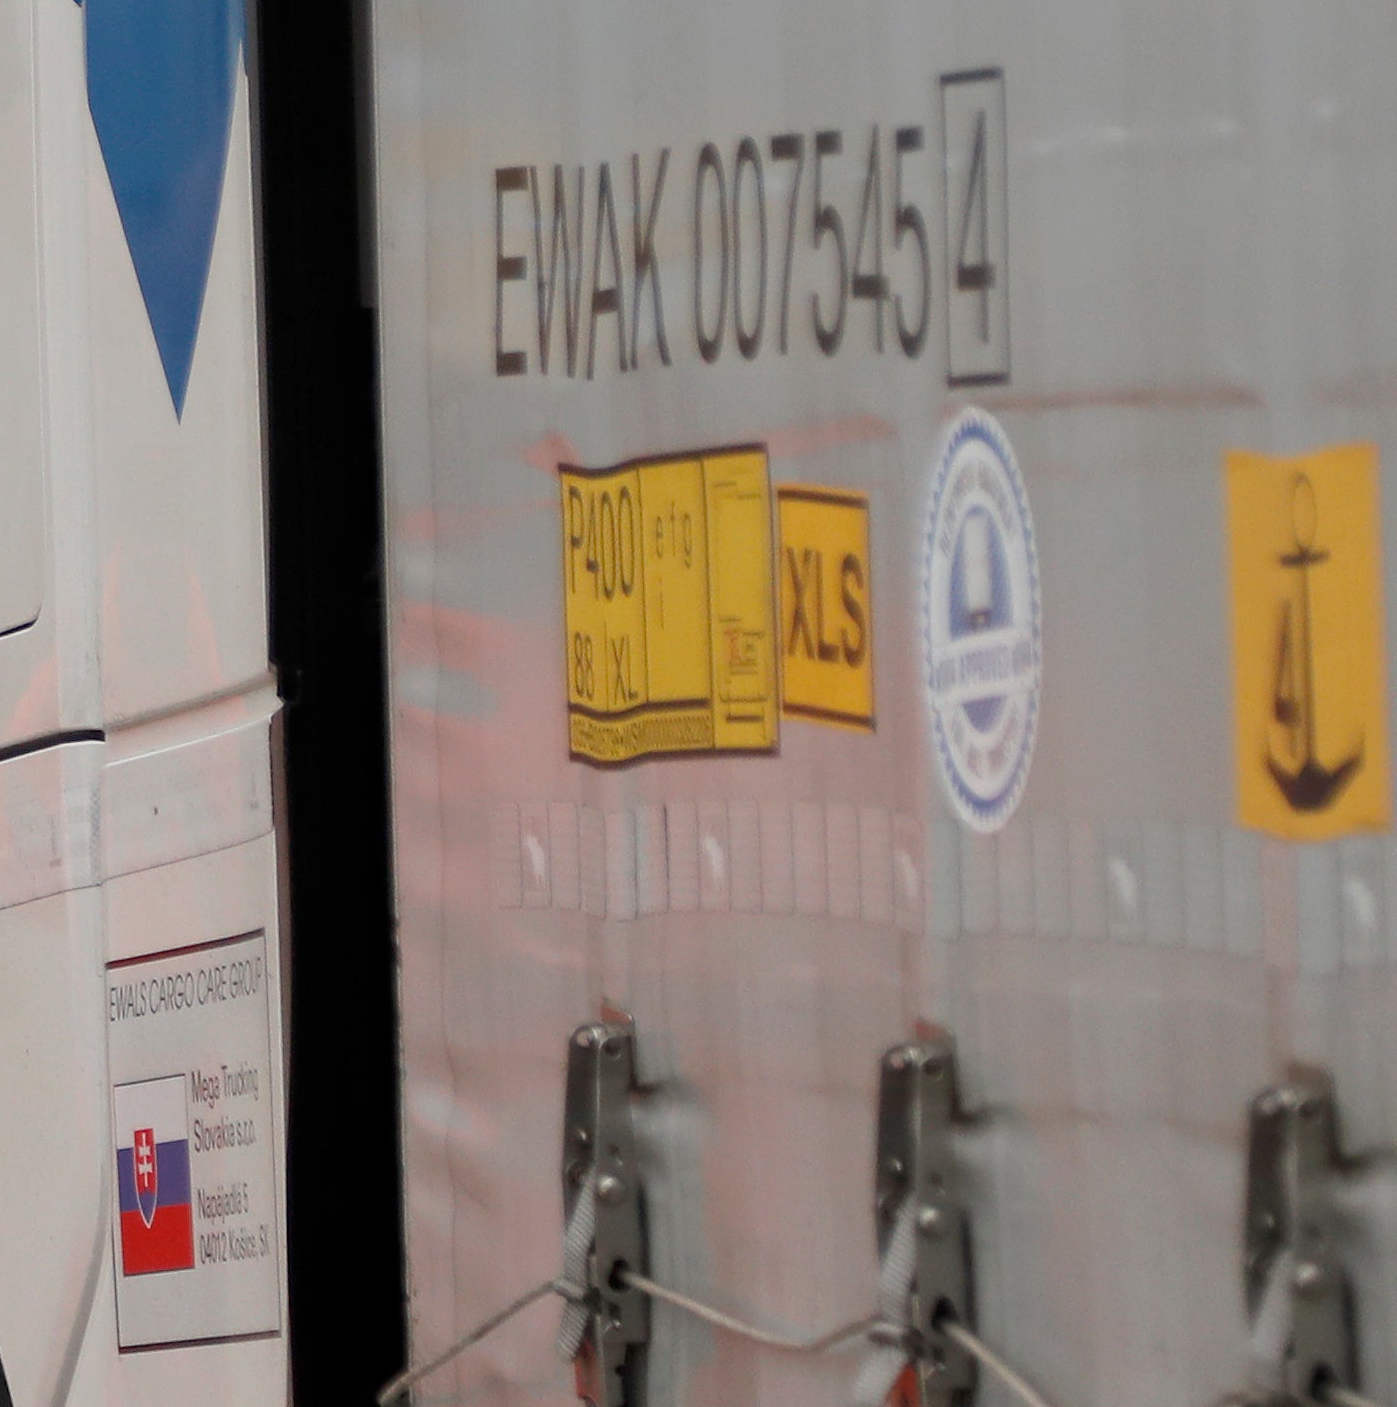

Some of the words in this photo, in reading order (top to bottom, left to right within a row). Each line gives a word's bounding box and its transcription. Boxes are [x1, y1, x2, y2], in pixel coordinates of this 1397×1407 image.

[495, 146, 672, 381] EWAK
[694, 122, 932, 365] 007545
[954, 108, 996, 345] 4
[569, 485, 636, 602] P400
[782, 546, 867, 669] XLS
[574, 630, 596, 702] 88
[611, 633, 639, 706] XL
[110, 980, 147, 1023] EWALS
[149, 972, 195, 1014] CARGO
[197, 964, 227, 1006] CARE
[229, 957, 264, 999] GROUP
[191, 1069, 220, 1110] Mega
[221, 1061, 259, 1102] Trucking
[194, 1114, 235, 1153] Slovakia
